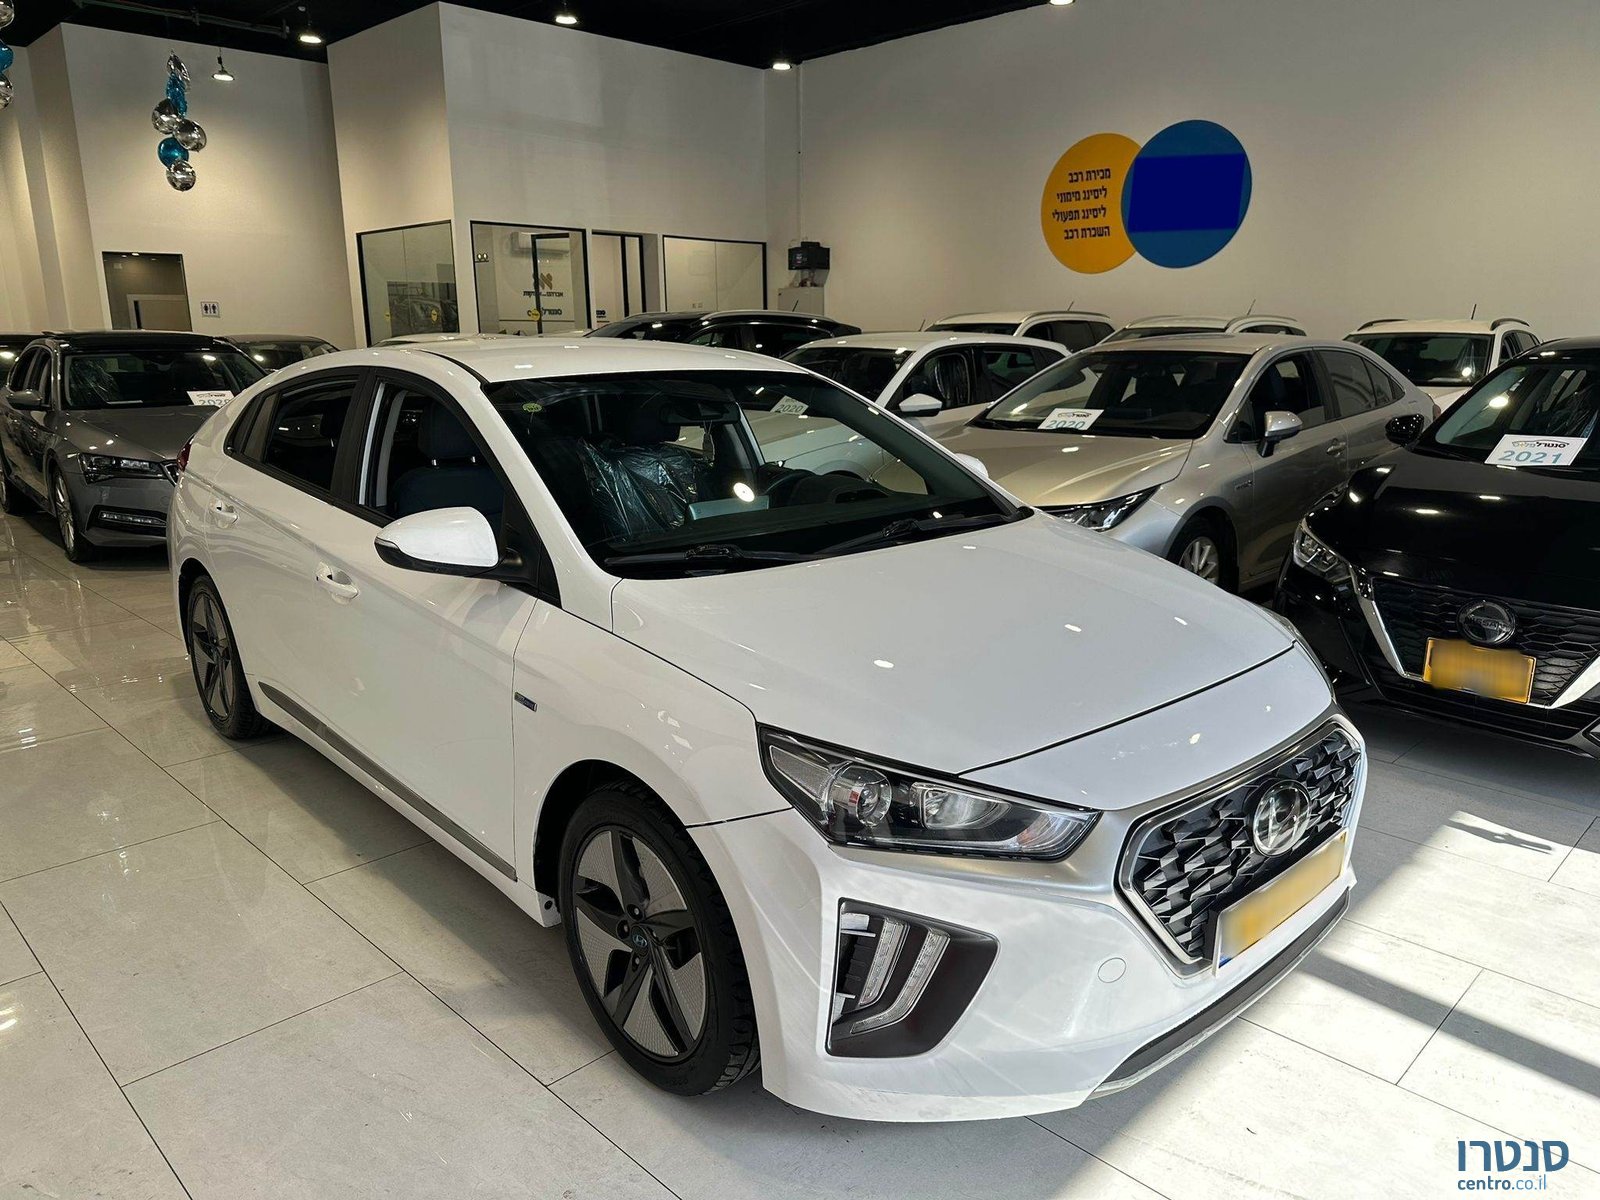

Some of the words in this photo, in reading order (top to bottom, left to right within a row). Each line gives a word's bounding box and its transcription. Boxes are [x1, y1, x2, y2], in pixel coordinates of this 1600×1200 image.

[1068, 171, 1083, 183] רכב
[1086, 168, 1111, 180] מכירת
[1083, 186, 1107, 200] ליסינג
[1052, 209, 1080, 222] תפעולי
[1082, 205, 1106, 219] ליסינג
[1064, 228, 1079, 240] רכב
[1081, 226, 1110, 238] השכרת
[776, 404, 804, 413] 2020
[1045, 420, 1086, 429] 2020
[1498, 450, 1563, 464] 2021
